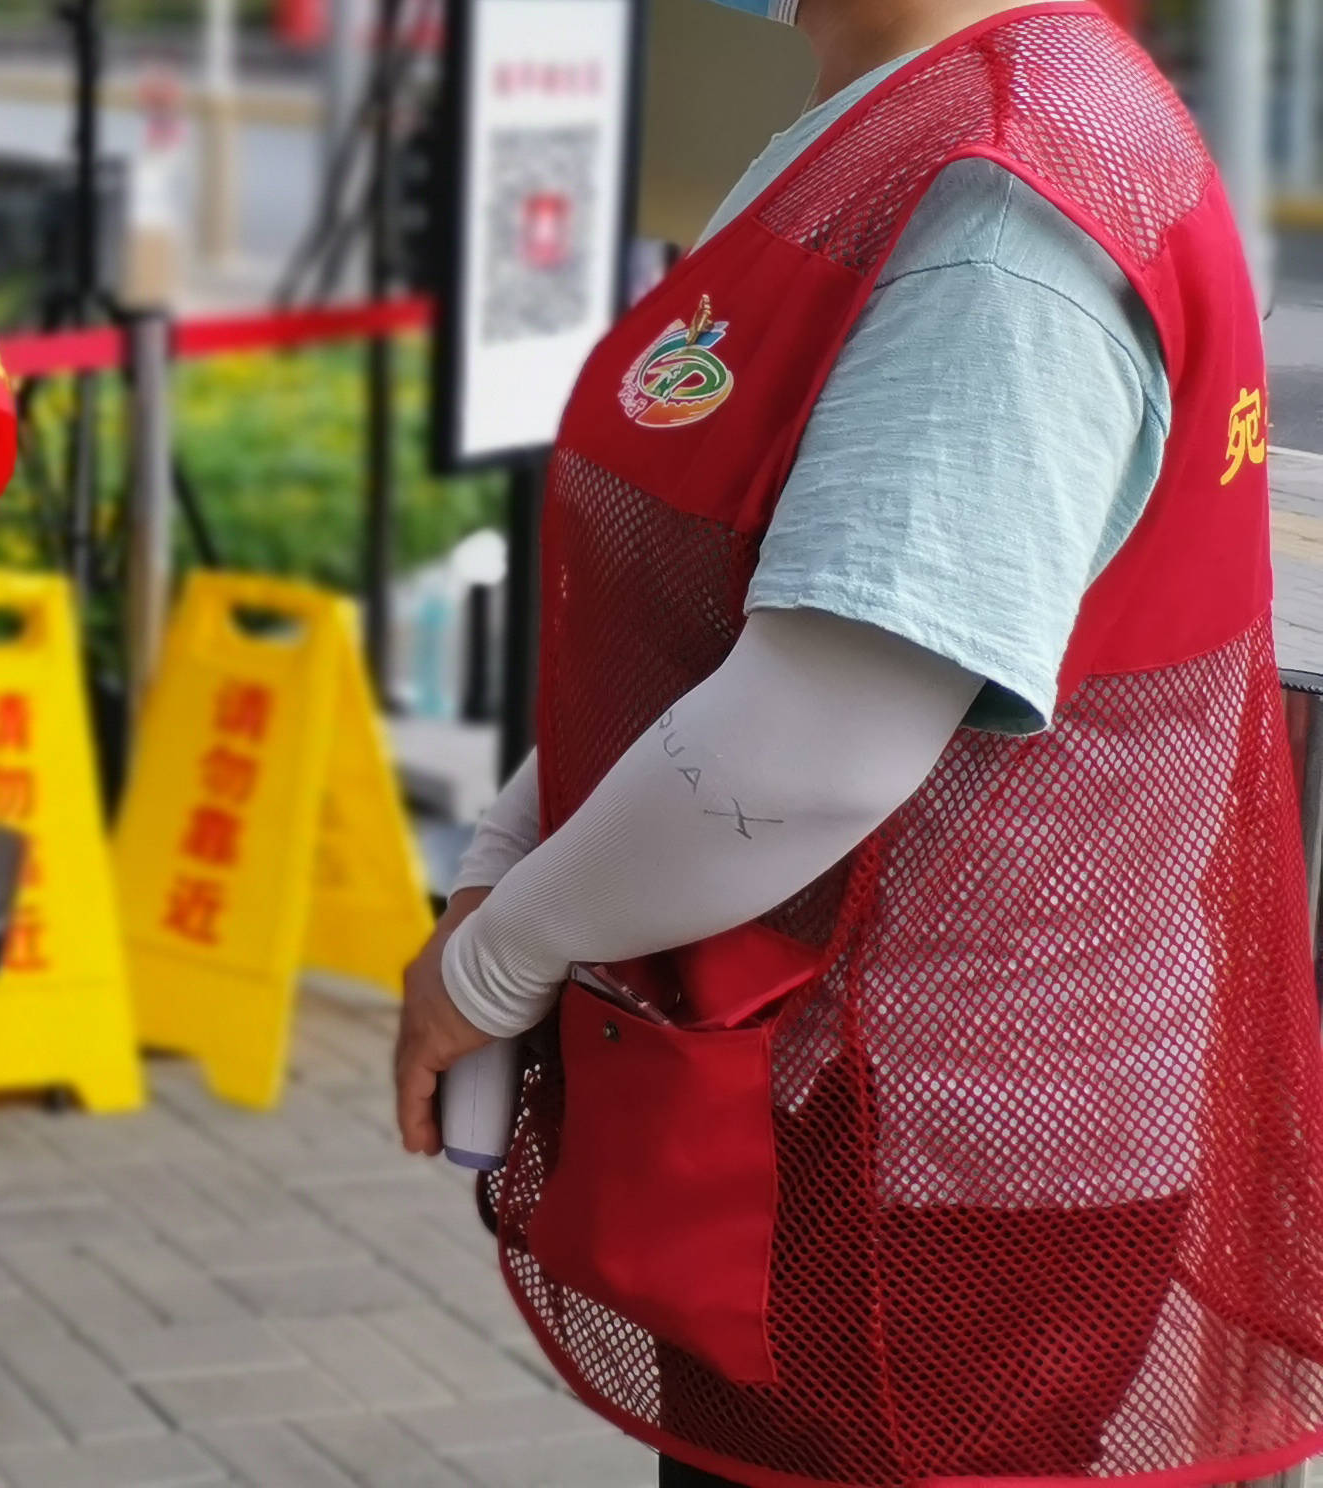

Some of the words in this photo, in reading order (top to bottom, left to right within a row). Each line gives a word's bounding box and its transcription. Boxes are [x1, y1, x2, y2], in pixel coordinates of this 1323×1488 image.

[1220, 387, 1266, 486] 宛
[163, 680, 273, 944] 请勿靠近
